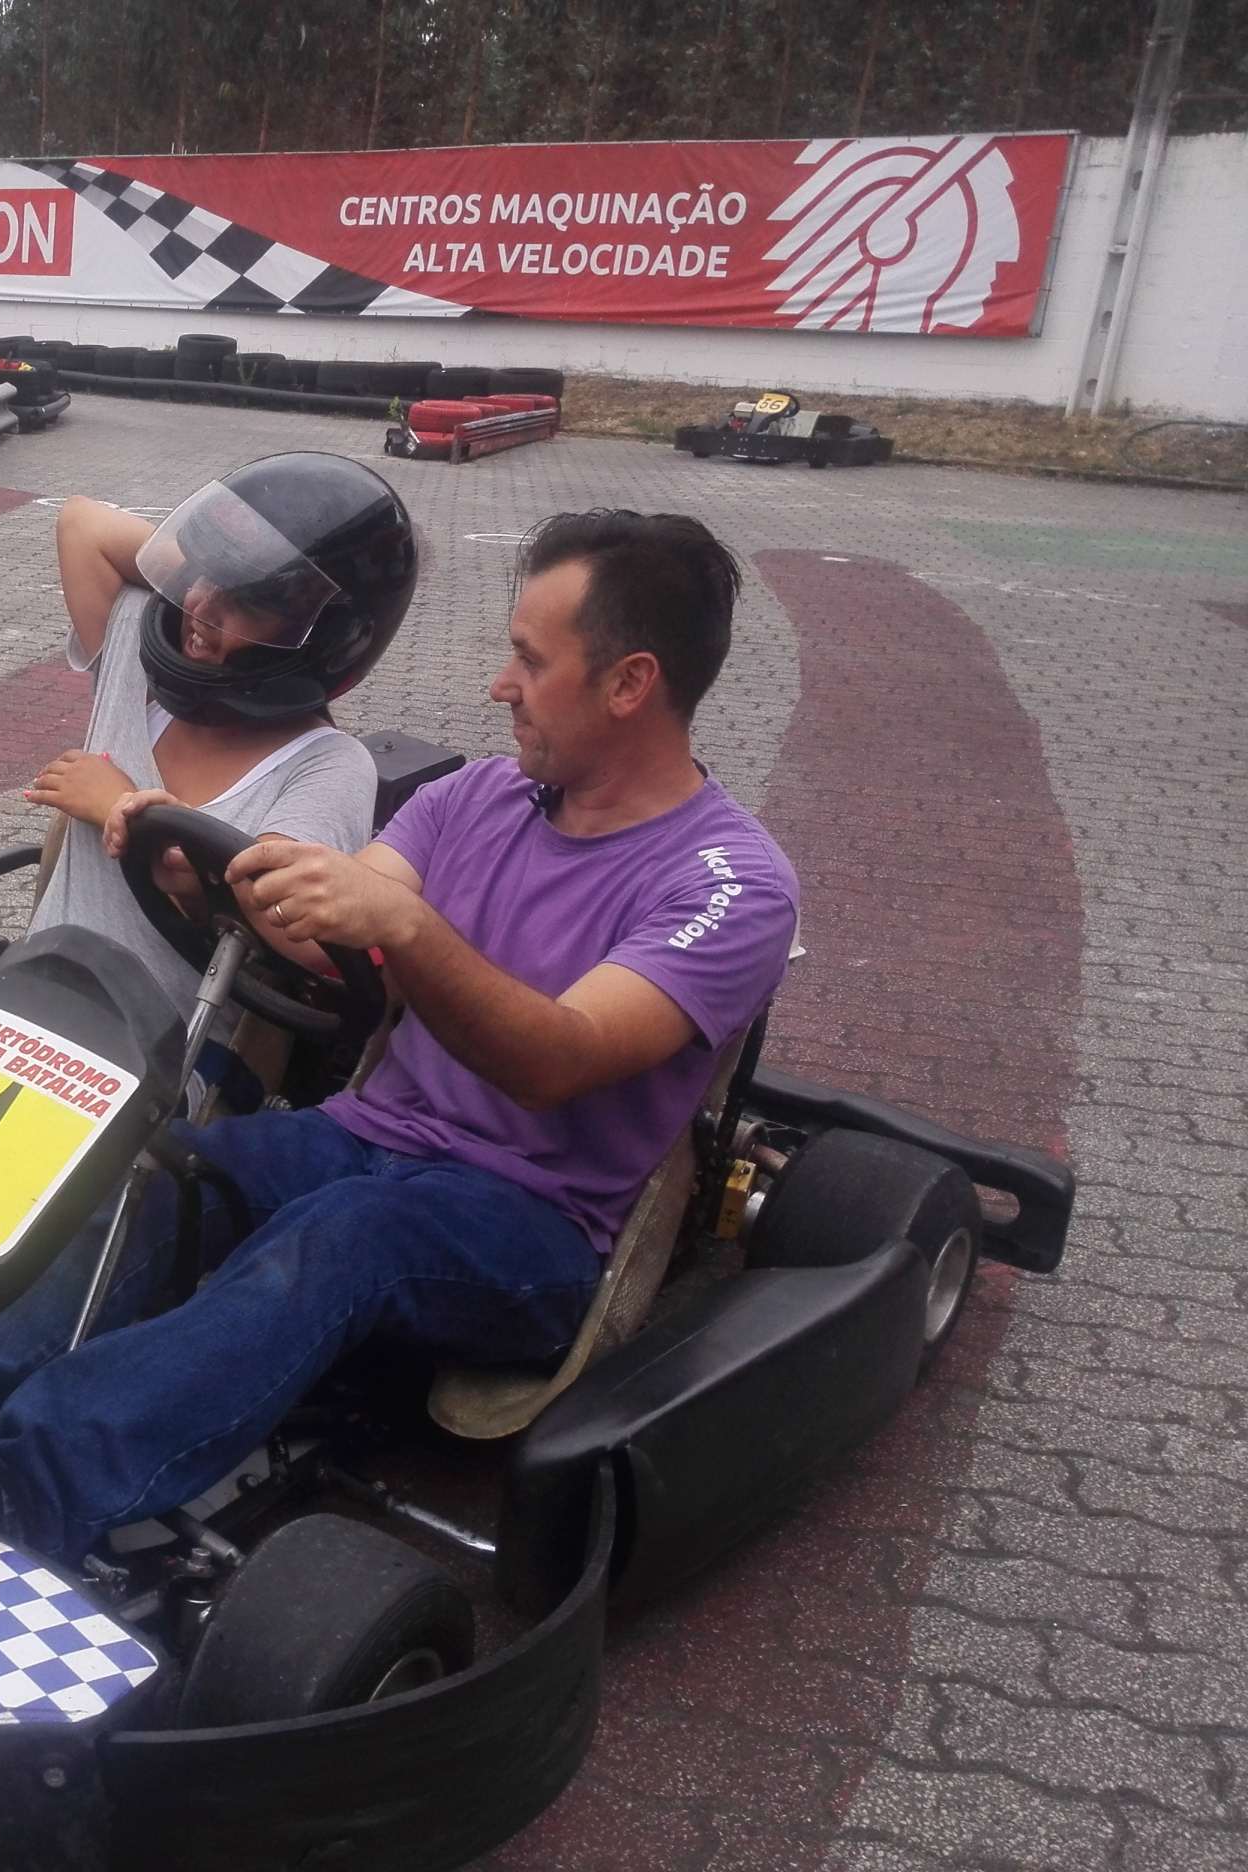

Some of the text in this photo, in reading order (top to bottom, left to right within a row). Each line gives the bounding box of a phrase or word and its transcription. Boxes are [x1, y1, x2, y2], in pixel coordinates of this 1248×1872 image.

[340, 183, 747, 234] CENTROS MAQUINAÇÃO
[403, 243, 731, 278] ALTA VELOCIDADE
[4, 1056, 112, 1119] BATALHA
